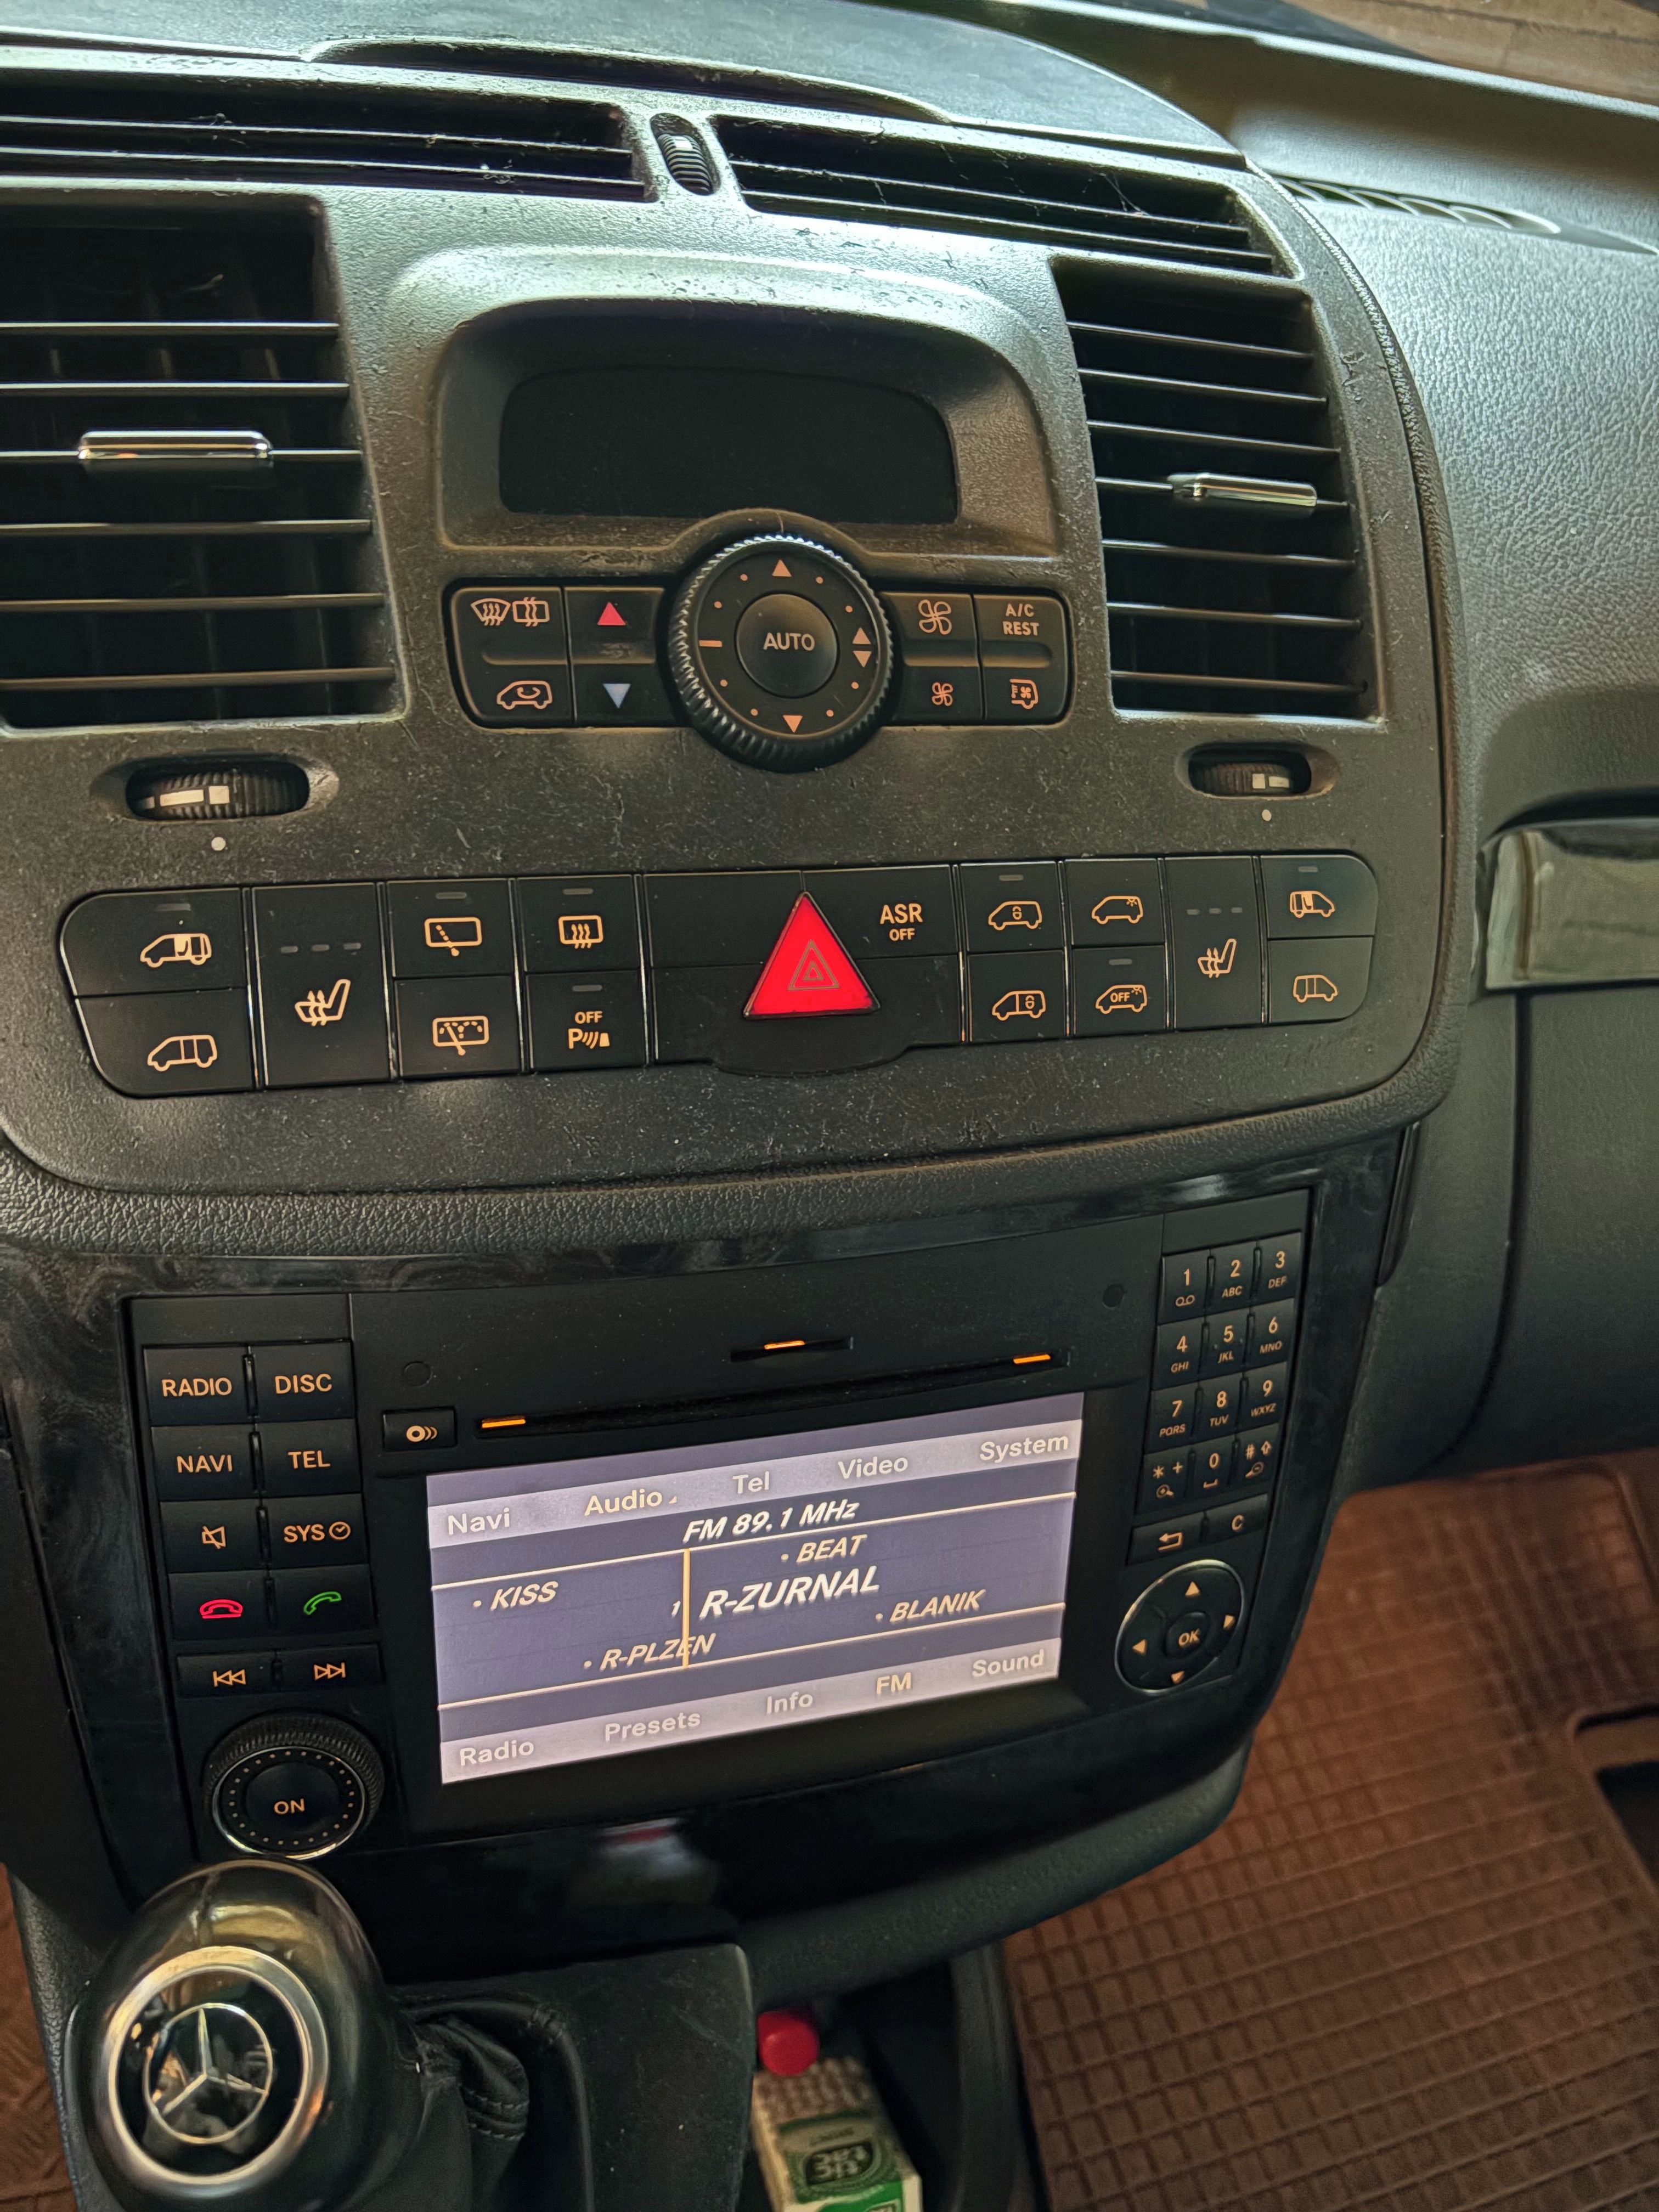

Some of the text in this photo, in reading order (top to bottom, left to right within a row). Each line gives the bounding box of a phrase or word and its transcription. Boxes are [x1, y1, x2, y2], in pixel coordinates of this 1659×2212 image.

[1005, 602, 1035, 619] A/C
[1003, 620, 1039, 637] REST
[763, 633, 815, 652] AUTO
[880, 903, 923, 926] ASR
[889, 928, 916, 941] OFF
[1110, 991, 1130, 1003] OFF
[574, 1010, 603, 1024] OFF
[1275, 1250, 1285, 1269] 3
[1183, 1268, 1190, 1286] 1
[1230, 1260, 1240, 1278] 2
[1268, 1276, 1288, 1289] DEF
[1221, 1285, 1243, 1299] ABC
[1223, 1325, 1234, 1342] 5
[1268, 1316, 1278, 1334] 6
[1176, 1335, 1188, 1352] 4
[1259, 1340, 1283, 1354] MNO
[1170, 1361, 1190, 1373] GHI
[1217, 1352, 1234, 1364] JKL
[161, 1378, 232, 1397] RADIO
[274, 1374, 332, 1394] DISC
[1262, 1380, 1273, 1397] 9
[1216, 1391, 1227, 1408] 8
[1171, 1400, 1183, 1418] 7
[1250, 1402, 1277, 1417] WXYZ
[1210, 1414, 1229, 1427] TUV
[1159, 1423, 1186, 1438] PQRS
[979, 1435, 1069, 1464] System
[176, 1454, 233, 1473] NAVI
[287, 1450, 331, 1469] TEL
[838, 1455, 909, 1480] Video
[1209, 1452, 1220, 1469] 0
[732, 1471, 770, 1494] Tel
[584, 1488, 663, 1516] Audio
[447, 1508, 511, 1535] Navi
[682, 1499, 860, 1543] FM 89.1 MHz
[1232, 1515, 1244, 1532] C
[284, 1523, 325, 1543] SYS
[795, 1534, 867, 1564] BEAT
[490, 1581, 559, 1611] KISS
[699, 1565, 881, 1620] R-ZURNAL
[889, 1589, 986, 1623] BLANIK
[1178, 1629, 1200, 1647] OK
[600, 1633, 716, 1671] R-PLZEN
[972, 1649, 1045, 1678] Sound
[877, 1672, 912, 1695] FM
[767, 1691, 814, 1715] Info
[605, 1712, 701, 1743] Presets
[459, 1740, 534, 1767] Radio
[273, 1798, 306, 1815] ON
